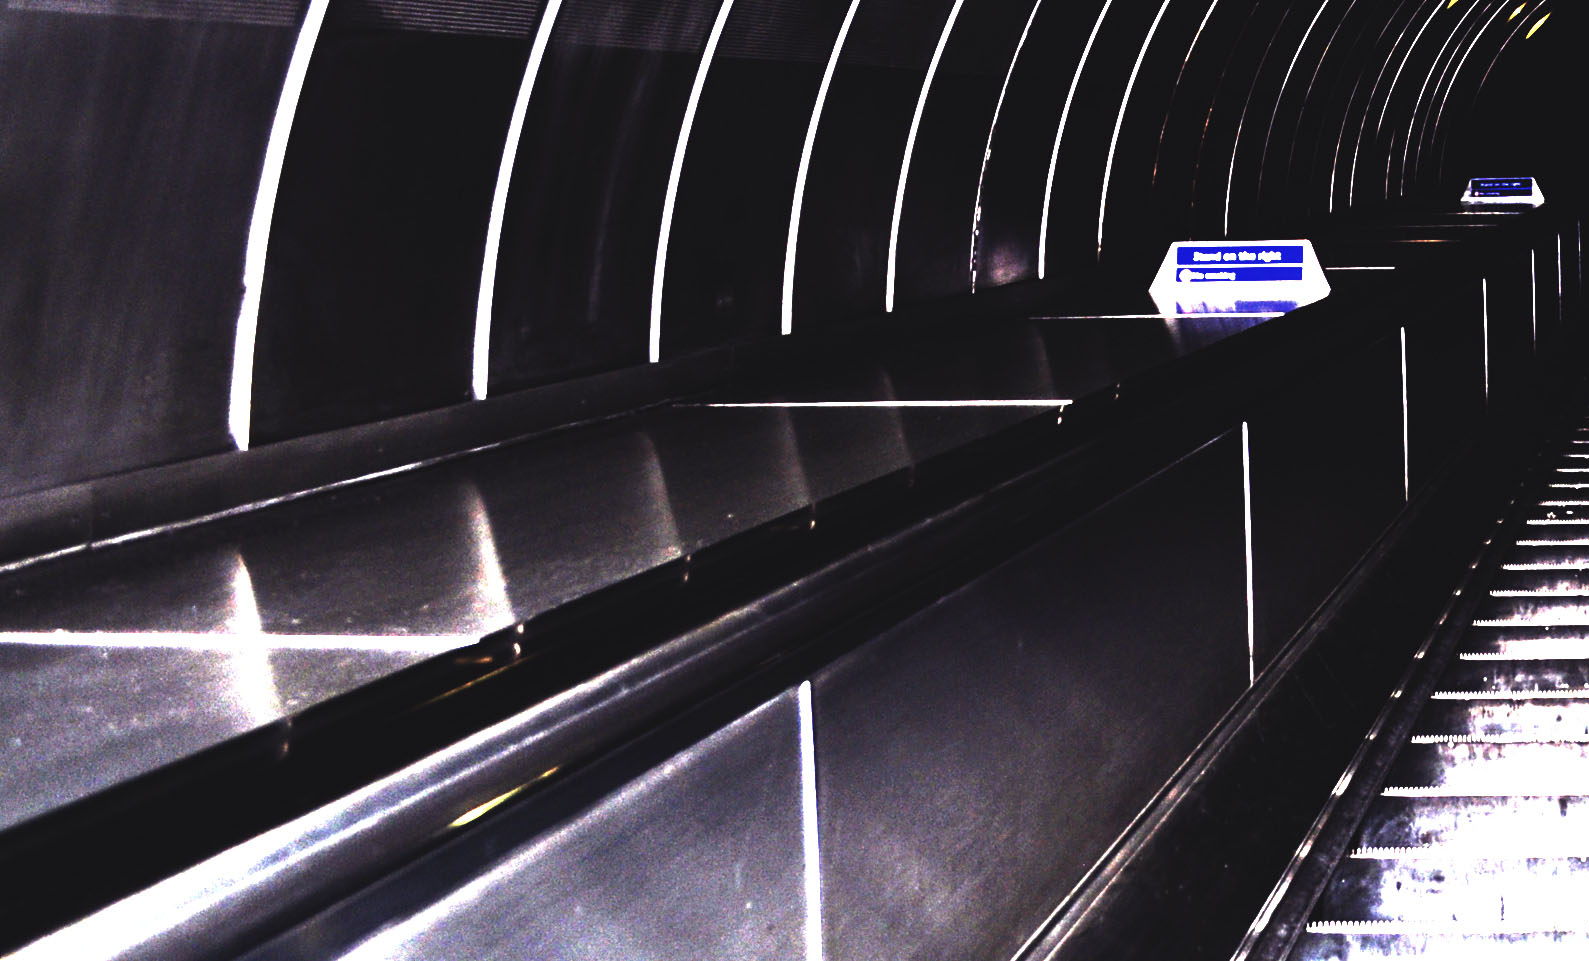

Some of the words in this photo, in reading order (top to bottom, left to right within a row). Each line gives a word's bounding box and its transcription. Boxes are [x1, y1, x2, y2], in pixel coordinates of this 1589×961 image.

[1192, 251, 1222, 262] Stand
[1222, 252, 1237, 262] on
[1237, 250, 1257, 262] the
[1257, 250, 1282, 263] right
